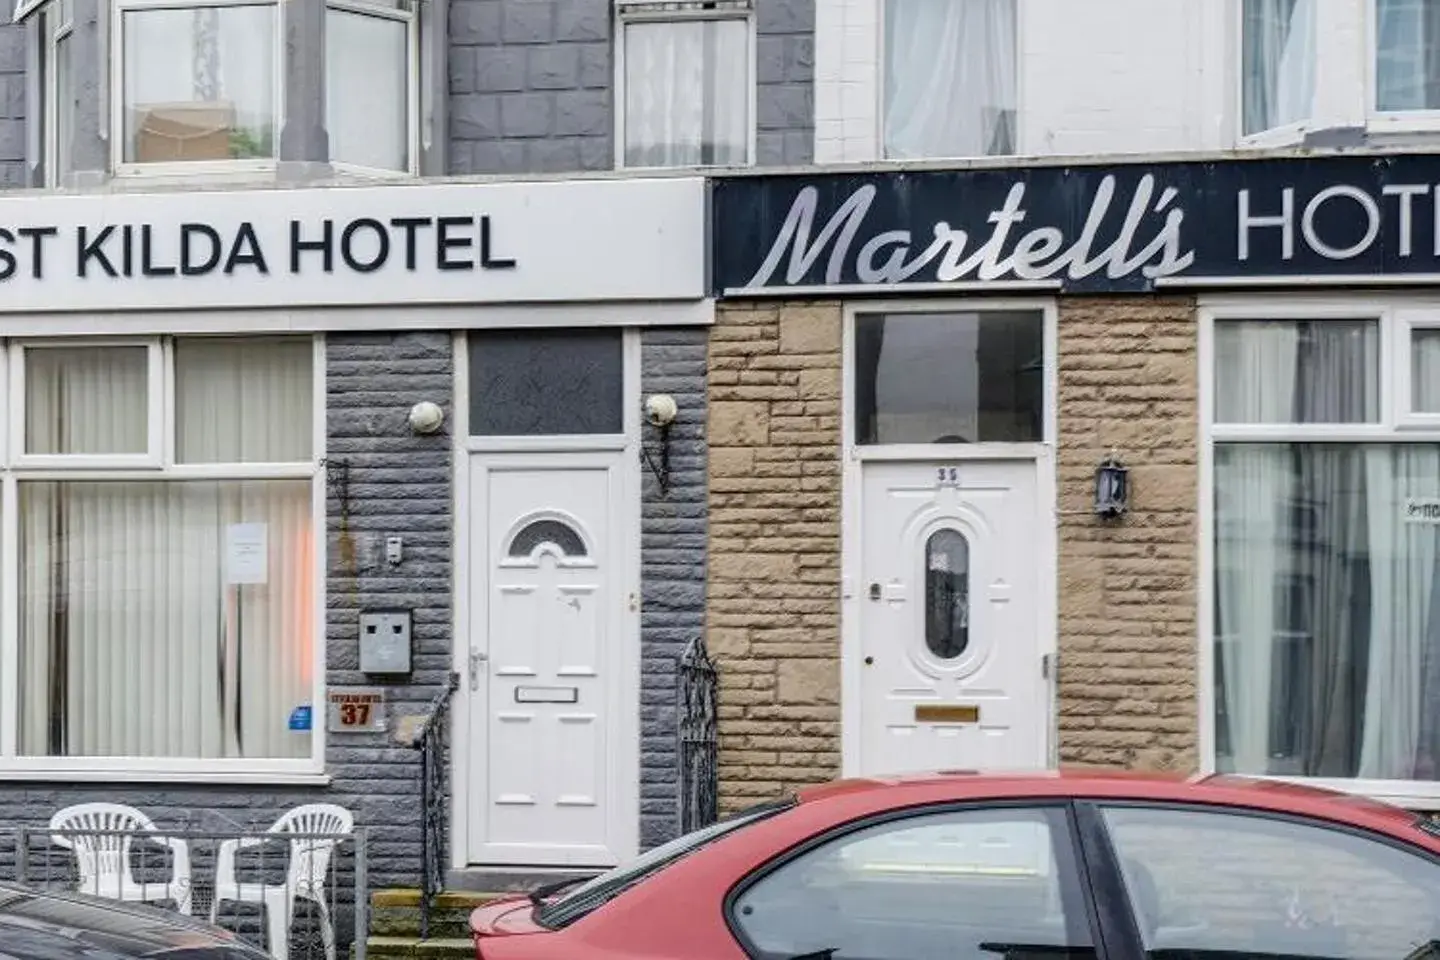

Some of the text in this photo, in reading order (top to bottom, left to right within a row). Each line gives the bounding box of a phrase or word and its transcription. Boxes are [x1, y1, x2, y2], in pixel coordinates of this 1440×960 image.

[76, 222, 269, 278] KILDA
[289, 215, 517, 274] HOTEL
[744, 173, 1440, 290] Martell's HOT
[341, 704, 370, 726] 37
